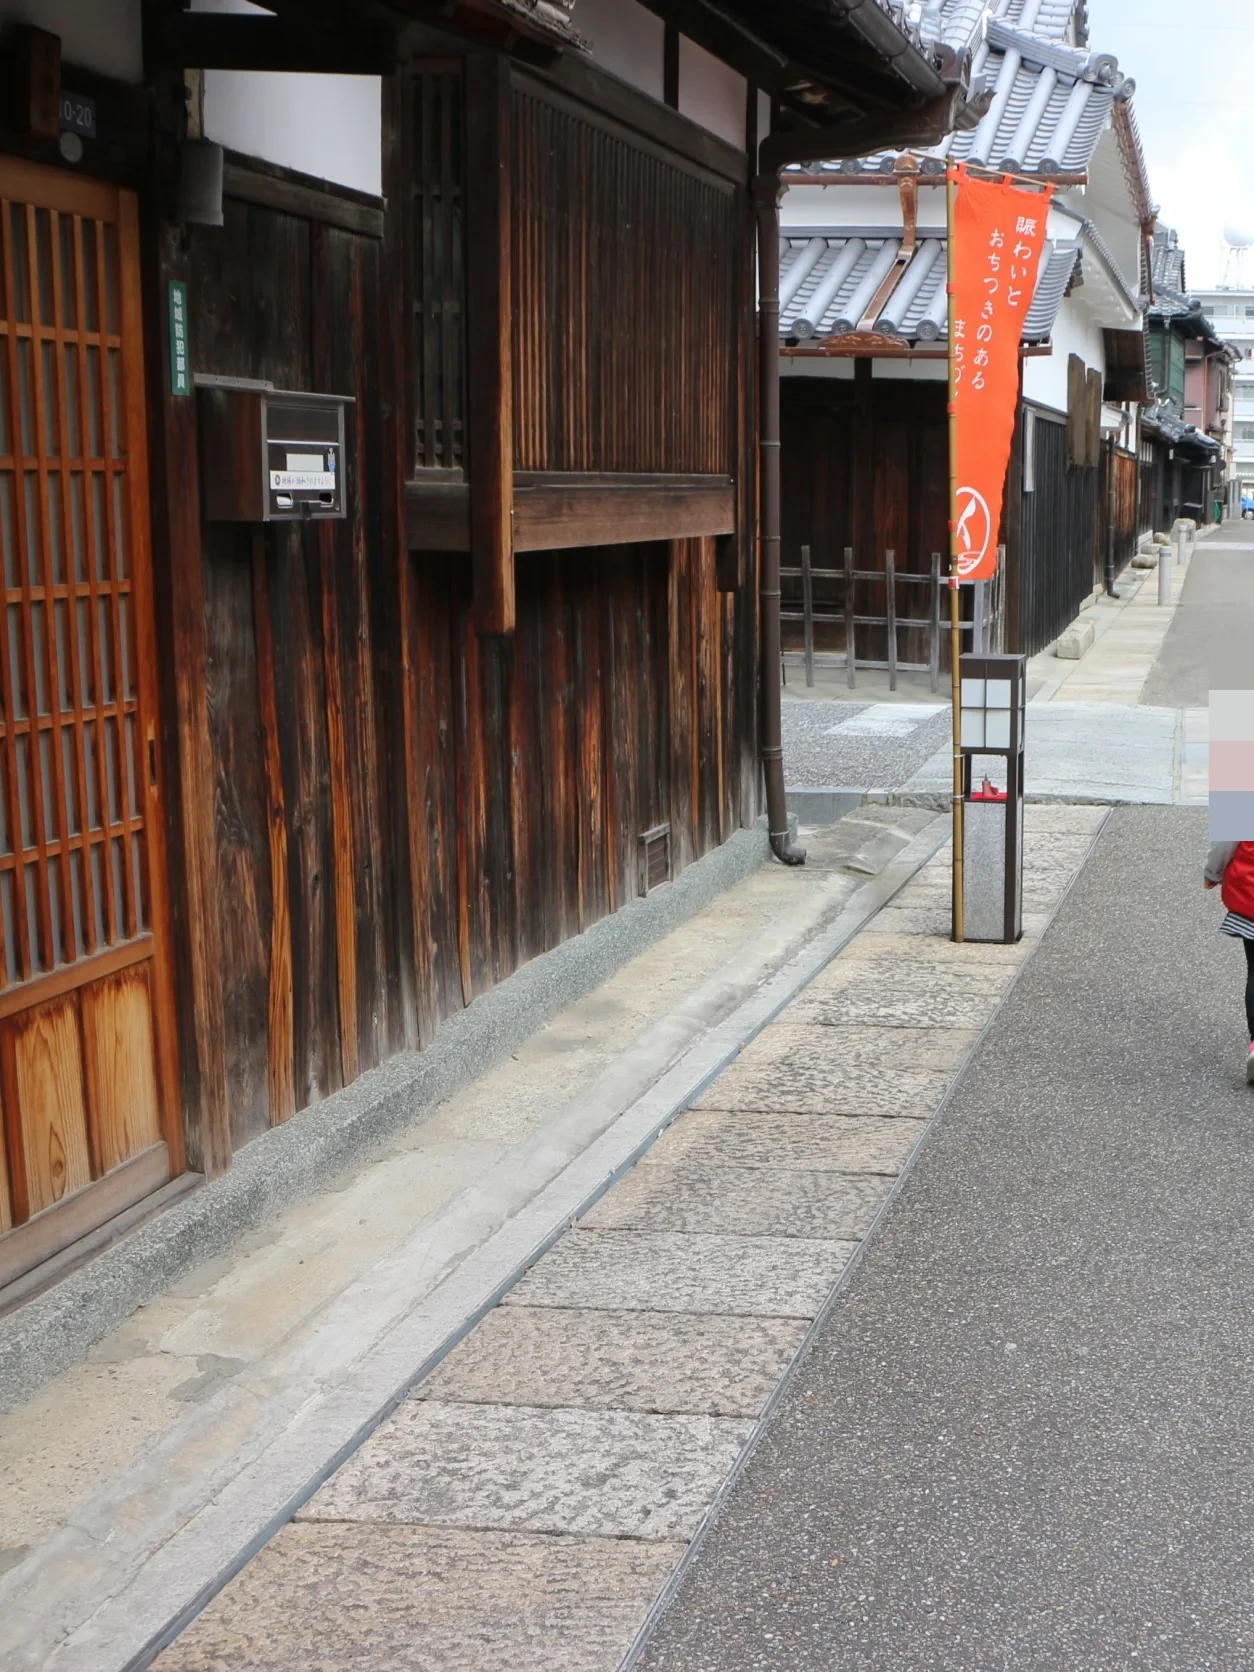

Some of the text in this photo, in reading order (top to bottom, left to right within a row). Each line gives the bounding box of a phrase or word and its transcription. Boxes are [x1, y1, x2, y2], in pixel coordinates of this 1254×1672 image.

[971, 228, 1005, 390] おちつきのある
[1007, 216, 1038, 306] 賑わいと
